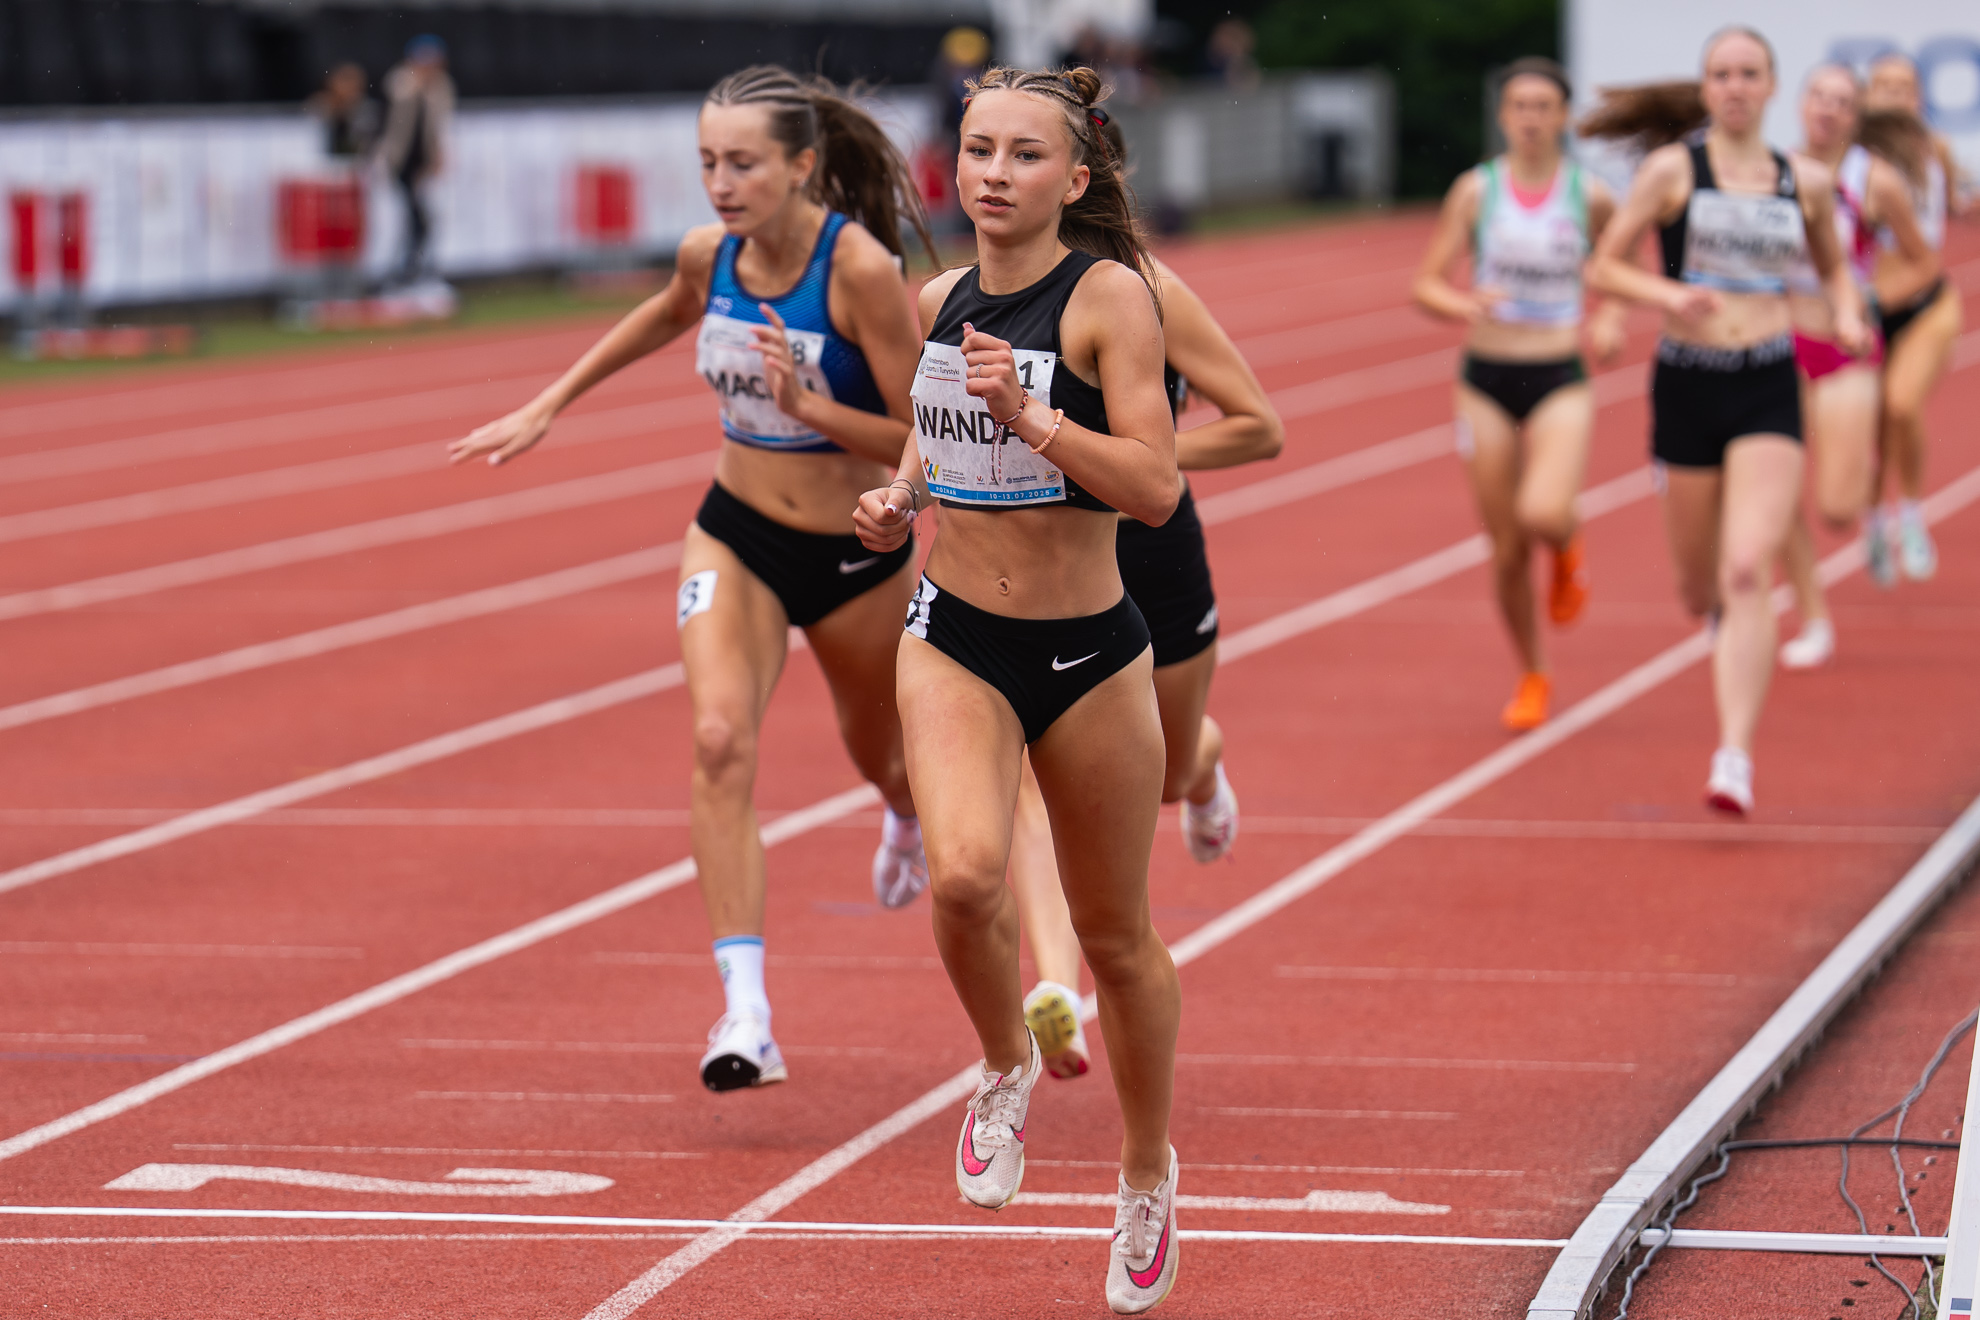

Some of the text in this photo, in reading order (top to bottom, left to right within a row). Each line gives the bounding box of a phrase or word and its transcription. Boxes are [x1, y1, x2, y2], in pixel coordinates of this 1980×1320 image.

[940, 366, 960, 376] Turystyki
[935, 486, 957, 496] POZNAŃ
[989, 490, 1050, 500] 10-13.07.2025
